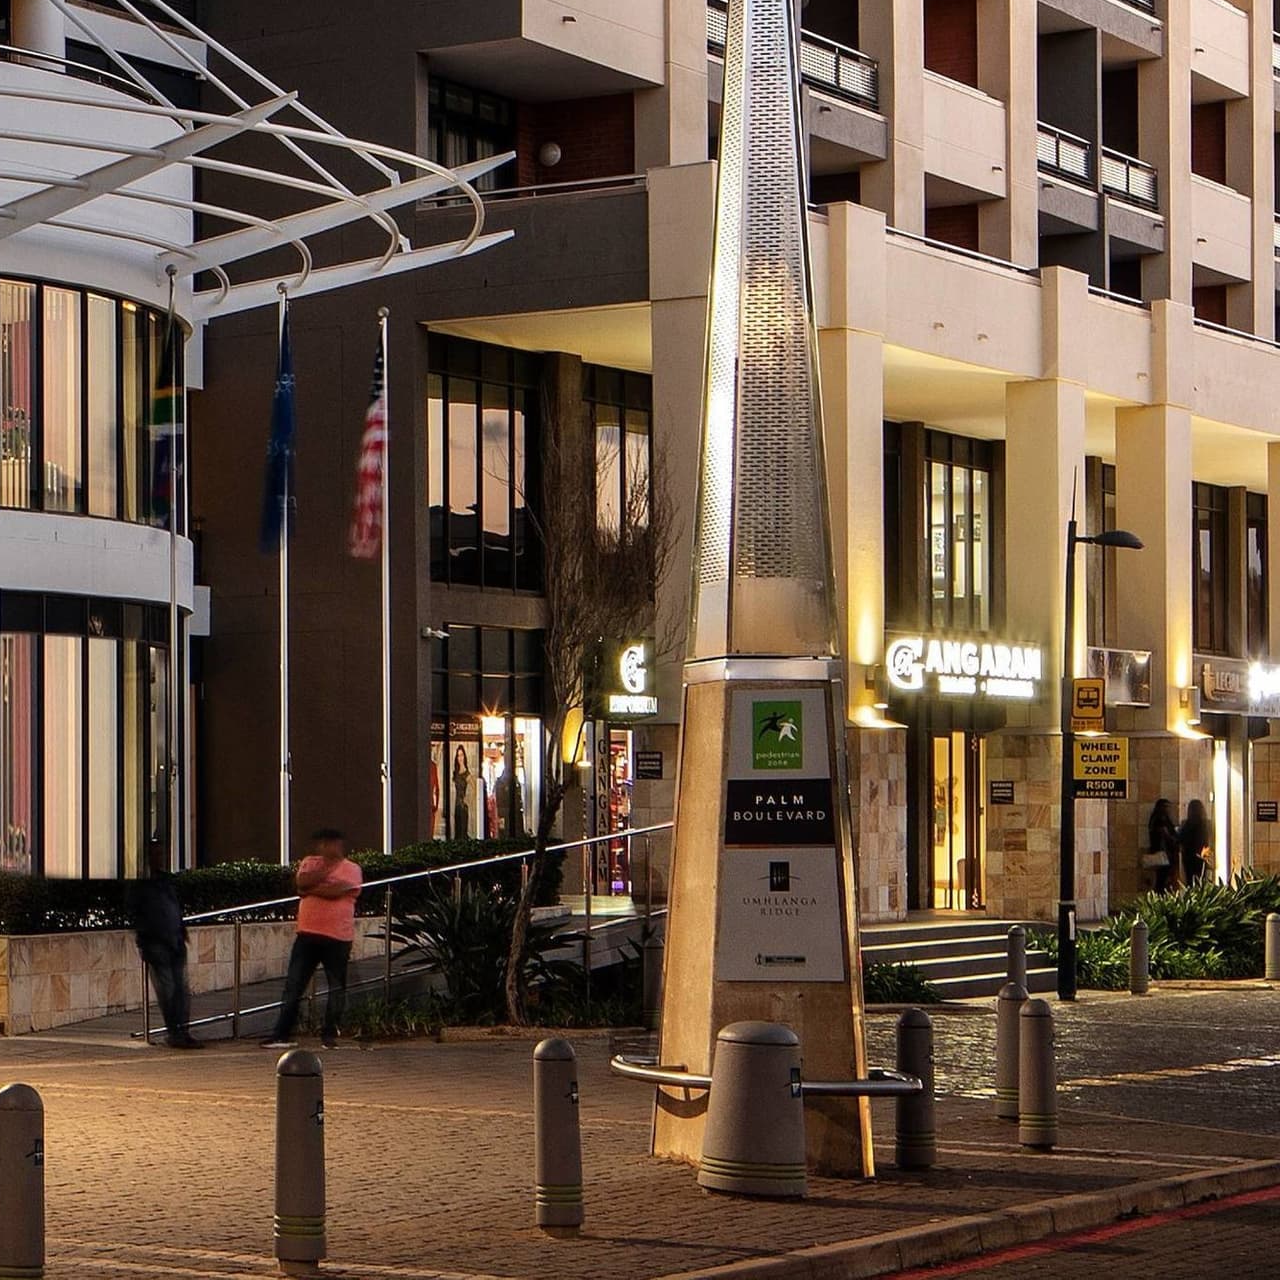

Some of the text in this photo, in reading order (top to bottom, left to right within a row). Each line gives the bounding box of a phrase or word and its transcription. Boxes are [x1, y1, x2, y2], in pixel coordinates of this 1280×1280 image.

[1080, 742, 1121, 751] WHEEL
[755, 751, 800, 761] pedestrian
[1080, 754, 1120, 763] CLAMP
[1084, 766, 1117, 775] ZONE
[1086, 781, 1115, 790] R500
[755, 795, 804, 805] PALM
[733, 810, 826, 821] BOULEVARD
[742, 897, 818, 906] UMHLANGA
[759, 907, 800, 916] RIDGE
